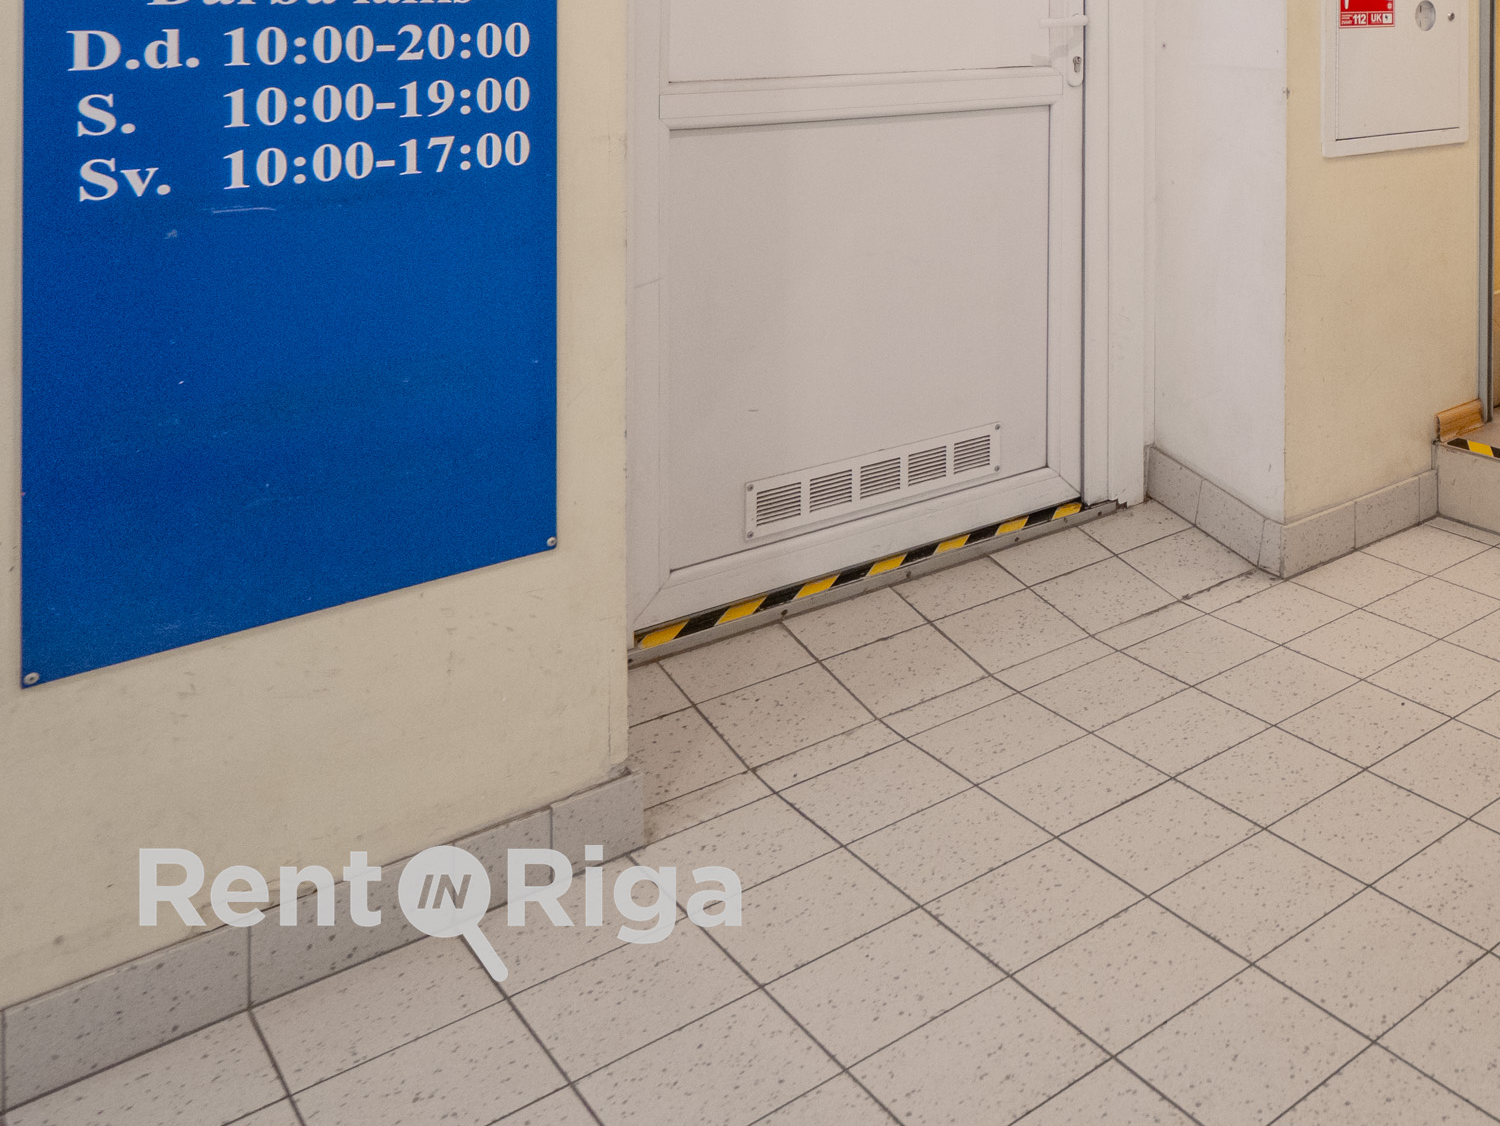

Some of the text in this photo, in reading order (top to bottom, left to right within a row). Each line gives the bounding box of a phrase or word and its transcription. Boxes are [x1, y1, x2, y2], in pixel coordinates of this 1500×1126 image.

[1353, 13, 1367, 24] 112
[66, 22, 531, 72] D.d. 10:00-20:00
[76, 76, 531, 137] S. 10:00-19:00
[78, 130, 531, 202] Sv. 10:00-17:00
